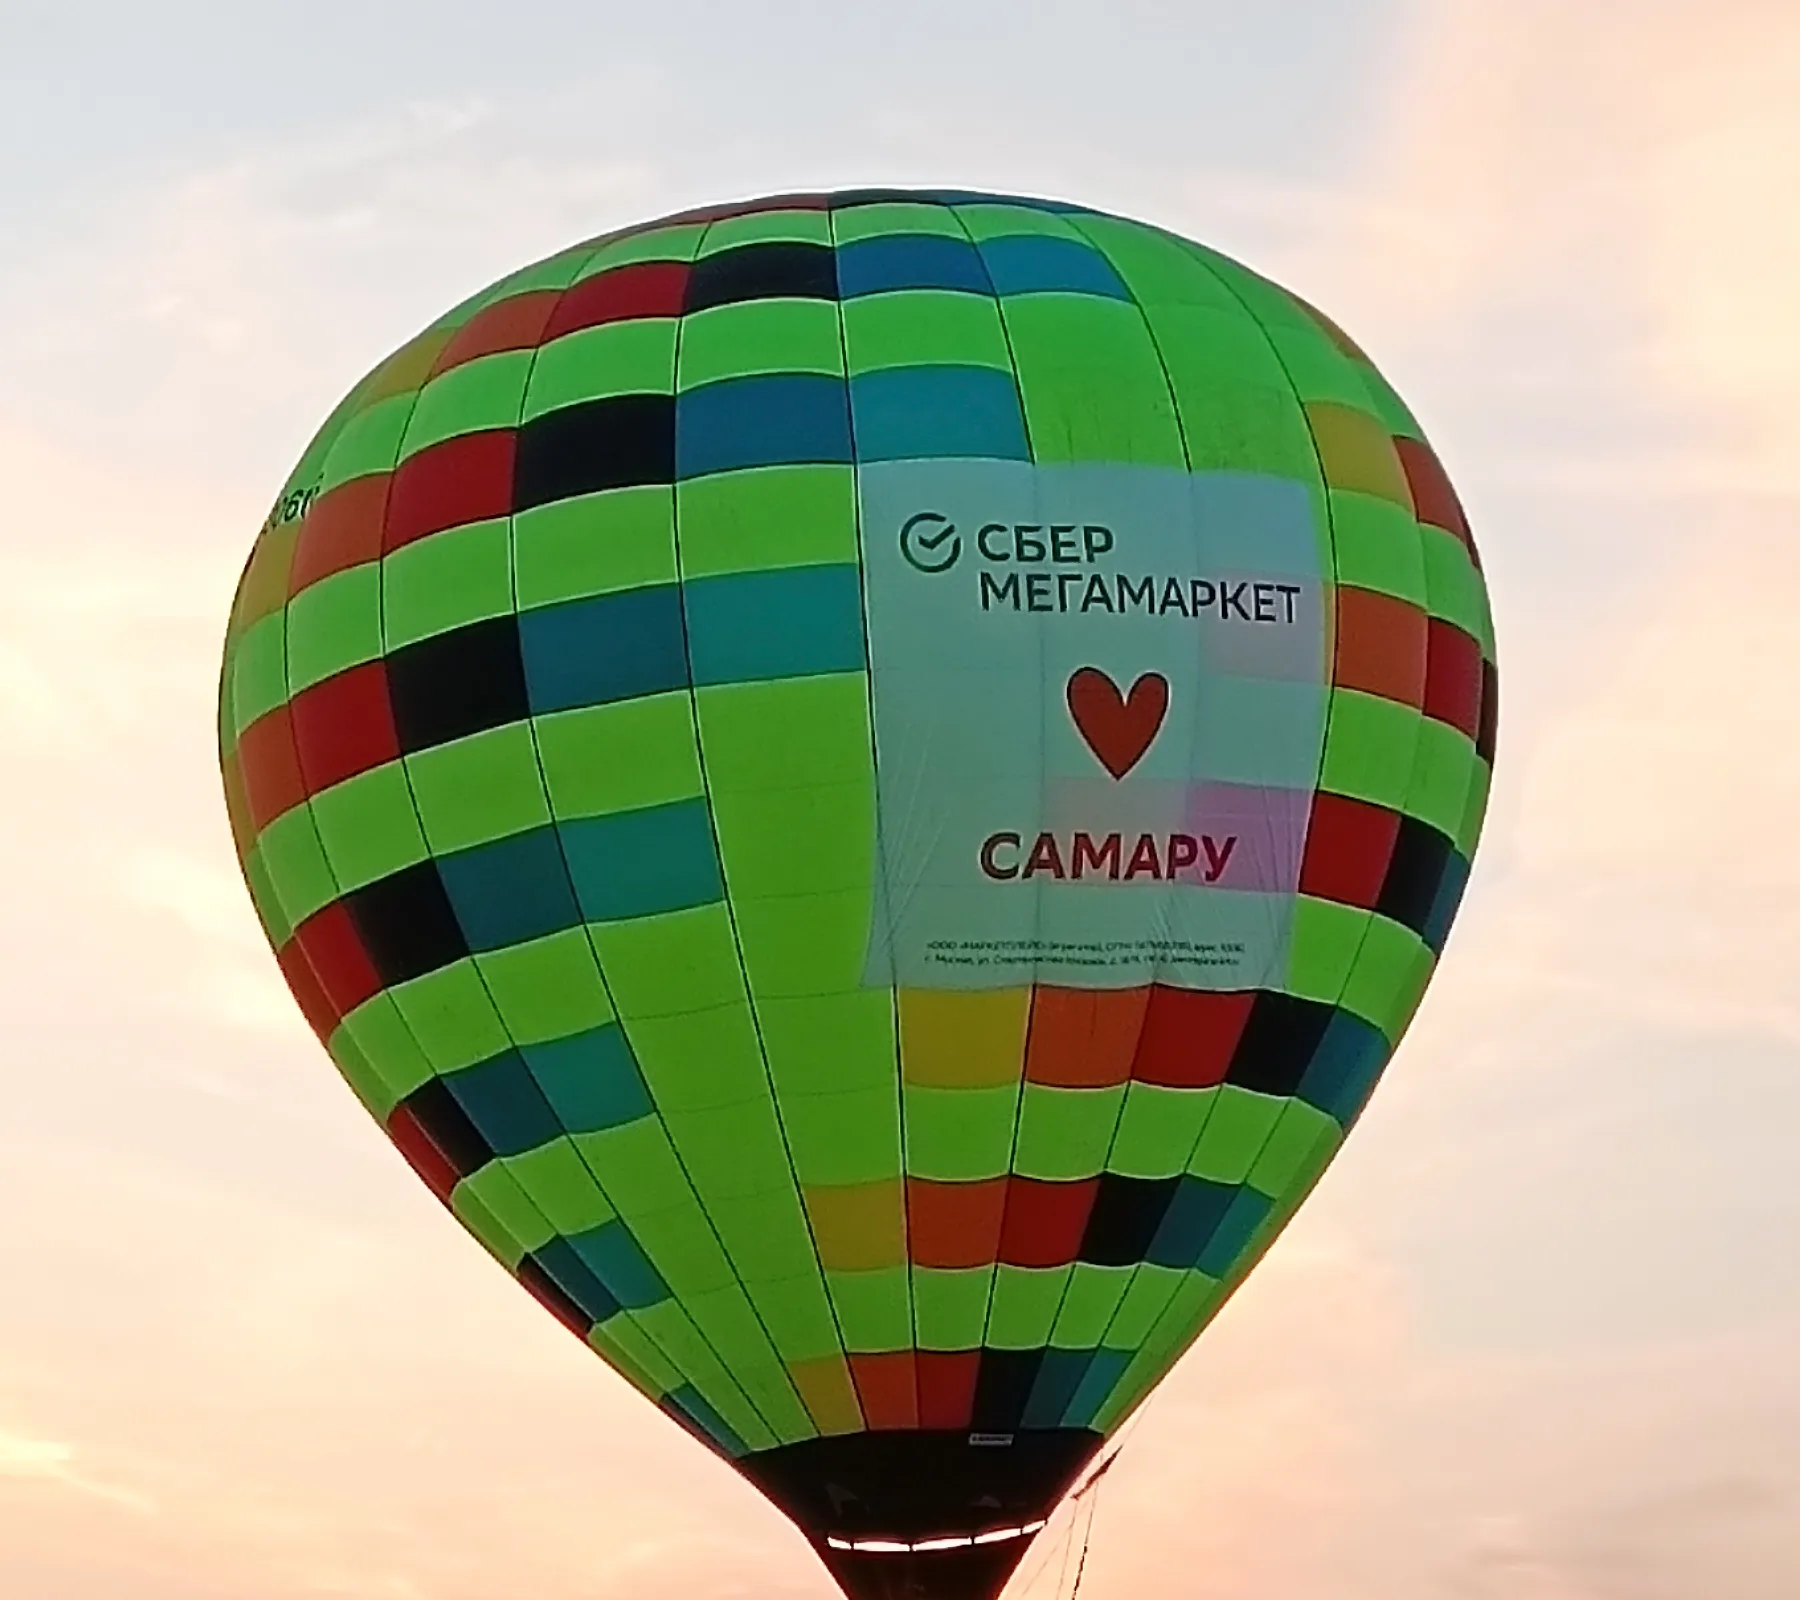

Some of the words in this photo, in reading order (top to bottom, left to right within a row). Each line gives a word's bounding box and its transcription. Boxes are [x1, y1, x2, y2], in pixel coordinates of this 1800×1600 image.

[978, 524, 1113, 564] СБЕР
[979, 571, 1301, 623] МЕГАМАРКЕТ
[980, 832, 1237, 882] САМАРУ
